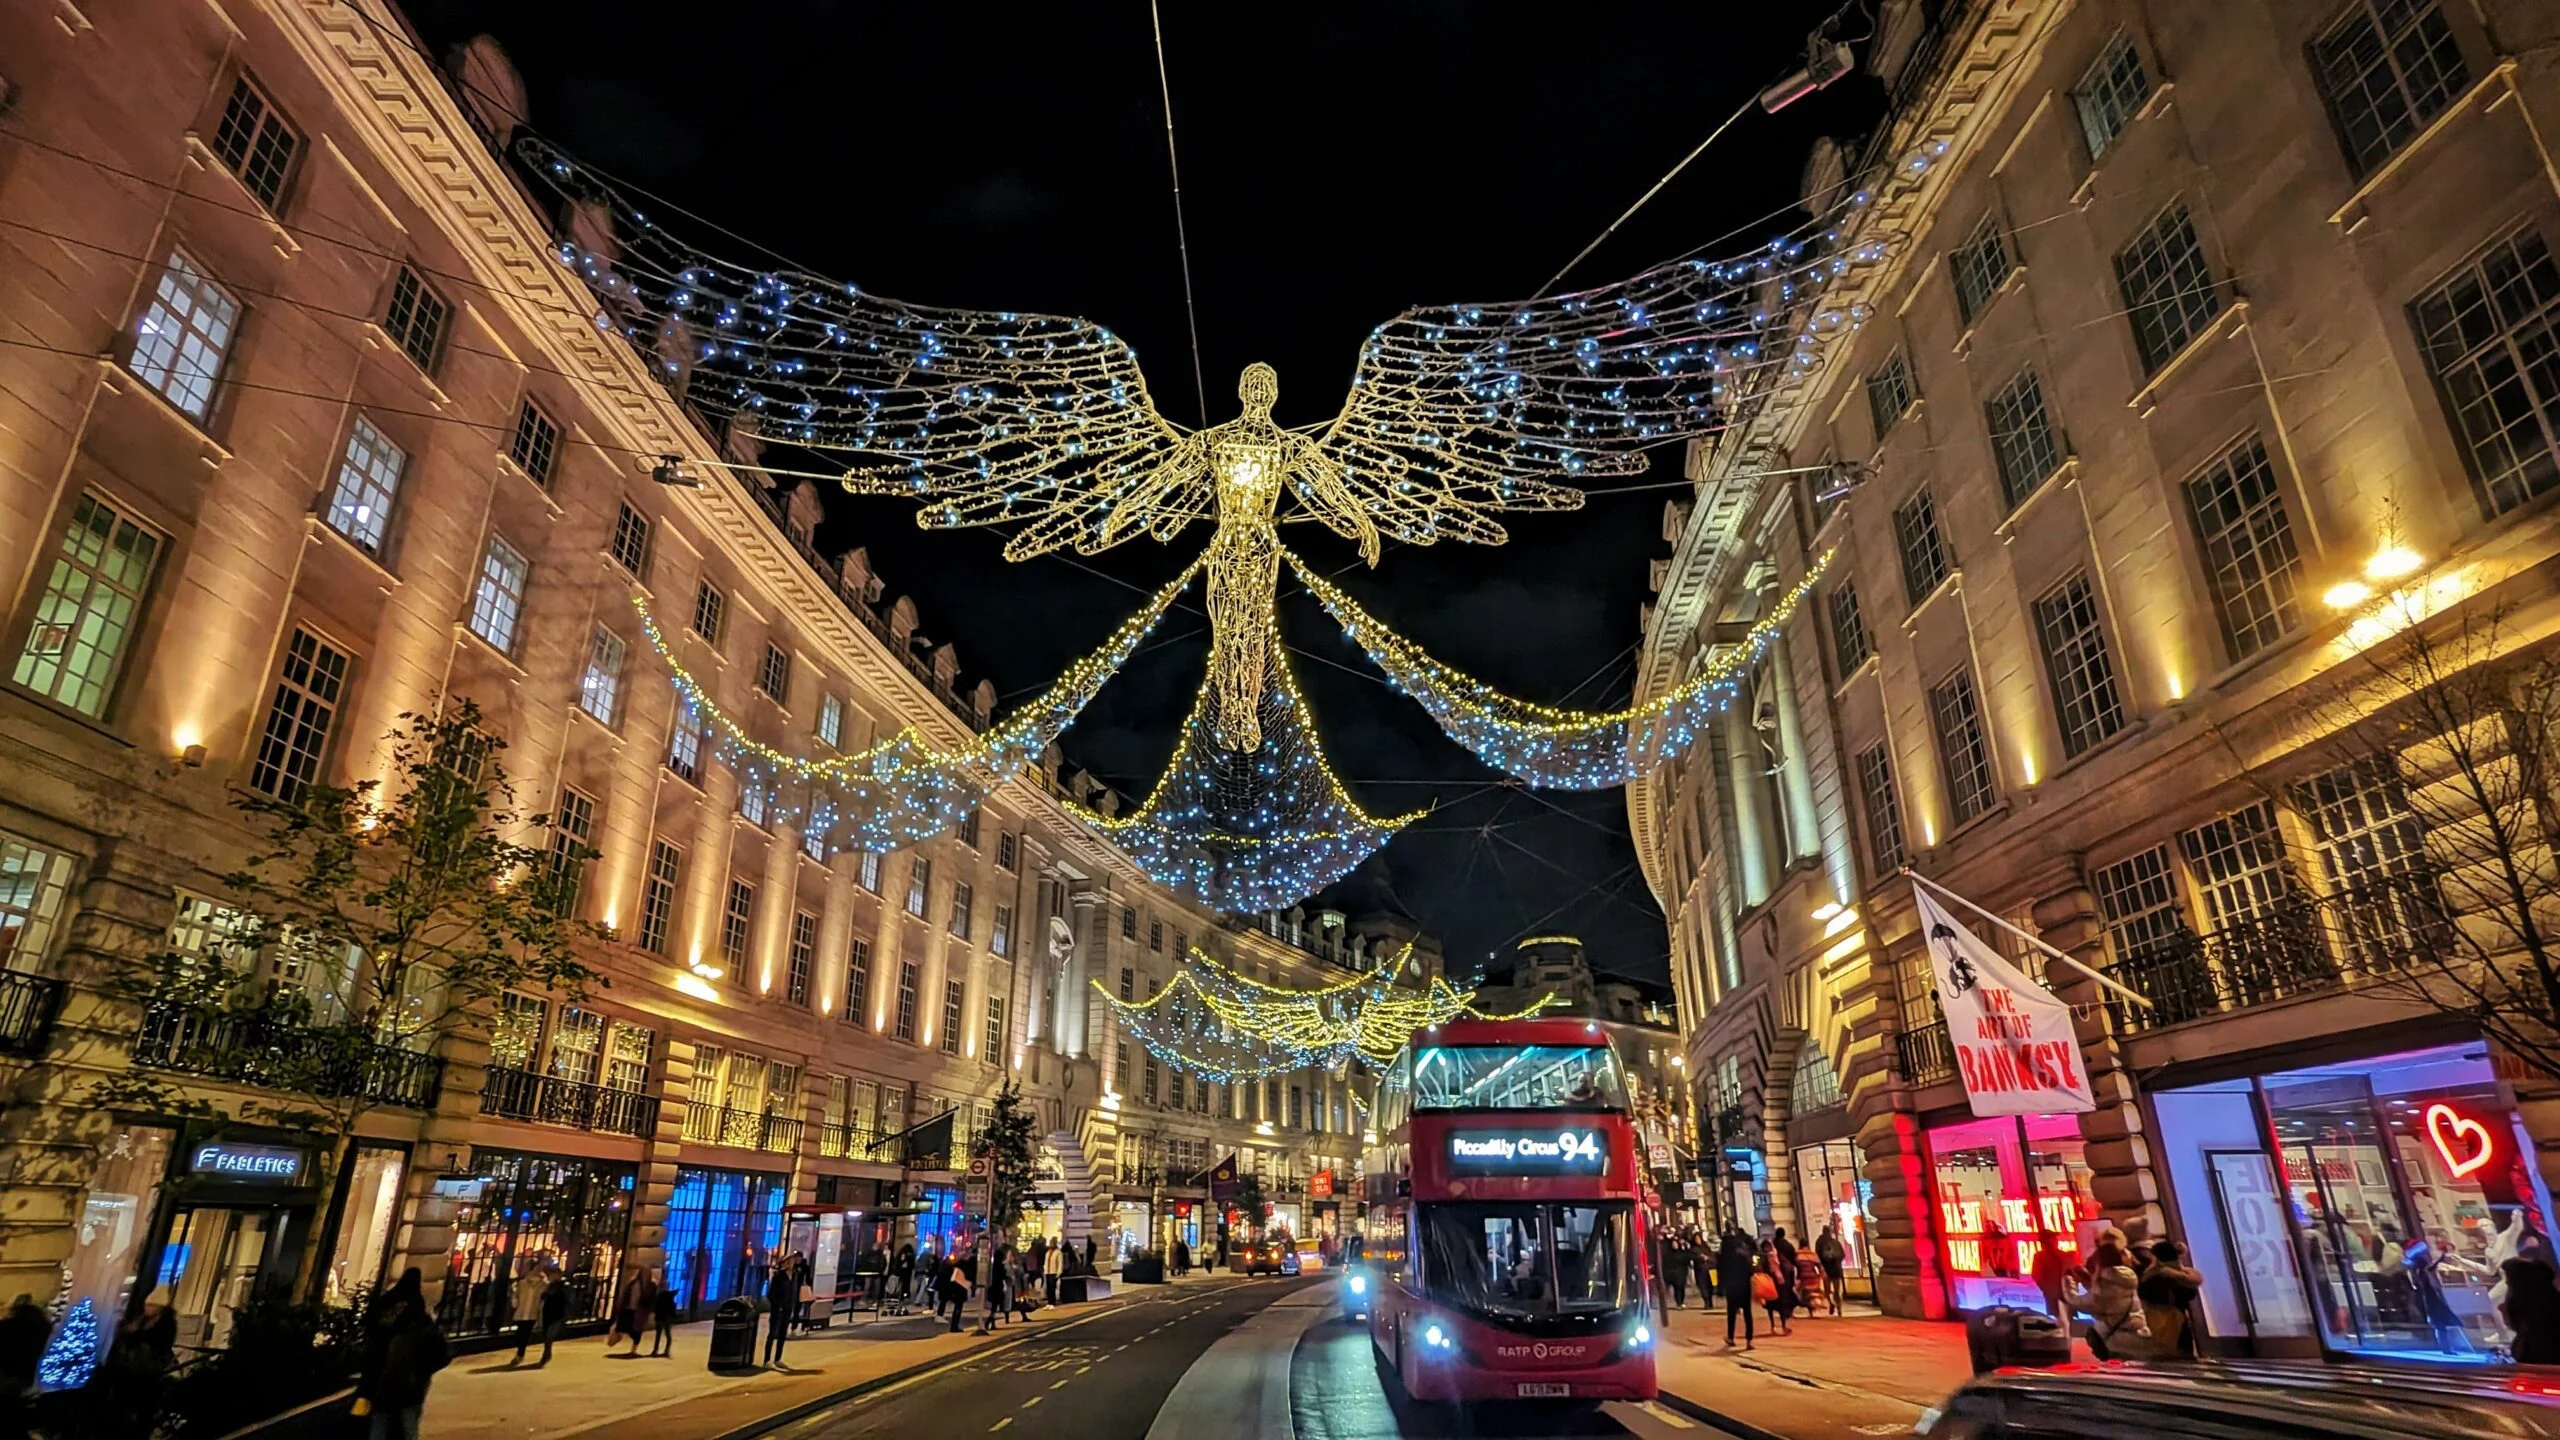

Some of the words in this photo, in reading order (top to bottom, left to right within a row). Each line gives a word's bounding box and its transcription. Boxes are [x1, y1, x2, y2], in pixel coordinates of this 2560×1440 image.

[1981, 989, 2015, 1013] THE
[1977, 1015, 2007, 1041] ART
[2011, 1014, 2032, 1039] OF
[1957, 1041, 2080, 1093] BANKSY
[1454, 1138, 1516, 1159] Piccadilly
[1518, 1138, 1560, 1156] Circus
[1558, 1132, 1600, 1161] 94
[216, 1153, 296, 1174] FABLETICS
[2000, 1199, 2031, 1233] THE
[1497, 1346, 1531, 1357] RATP
[1548, 1345, 1586, 1357] GROUP
